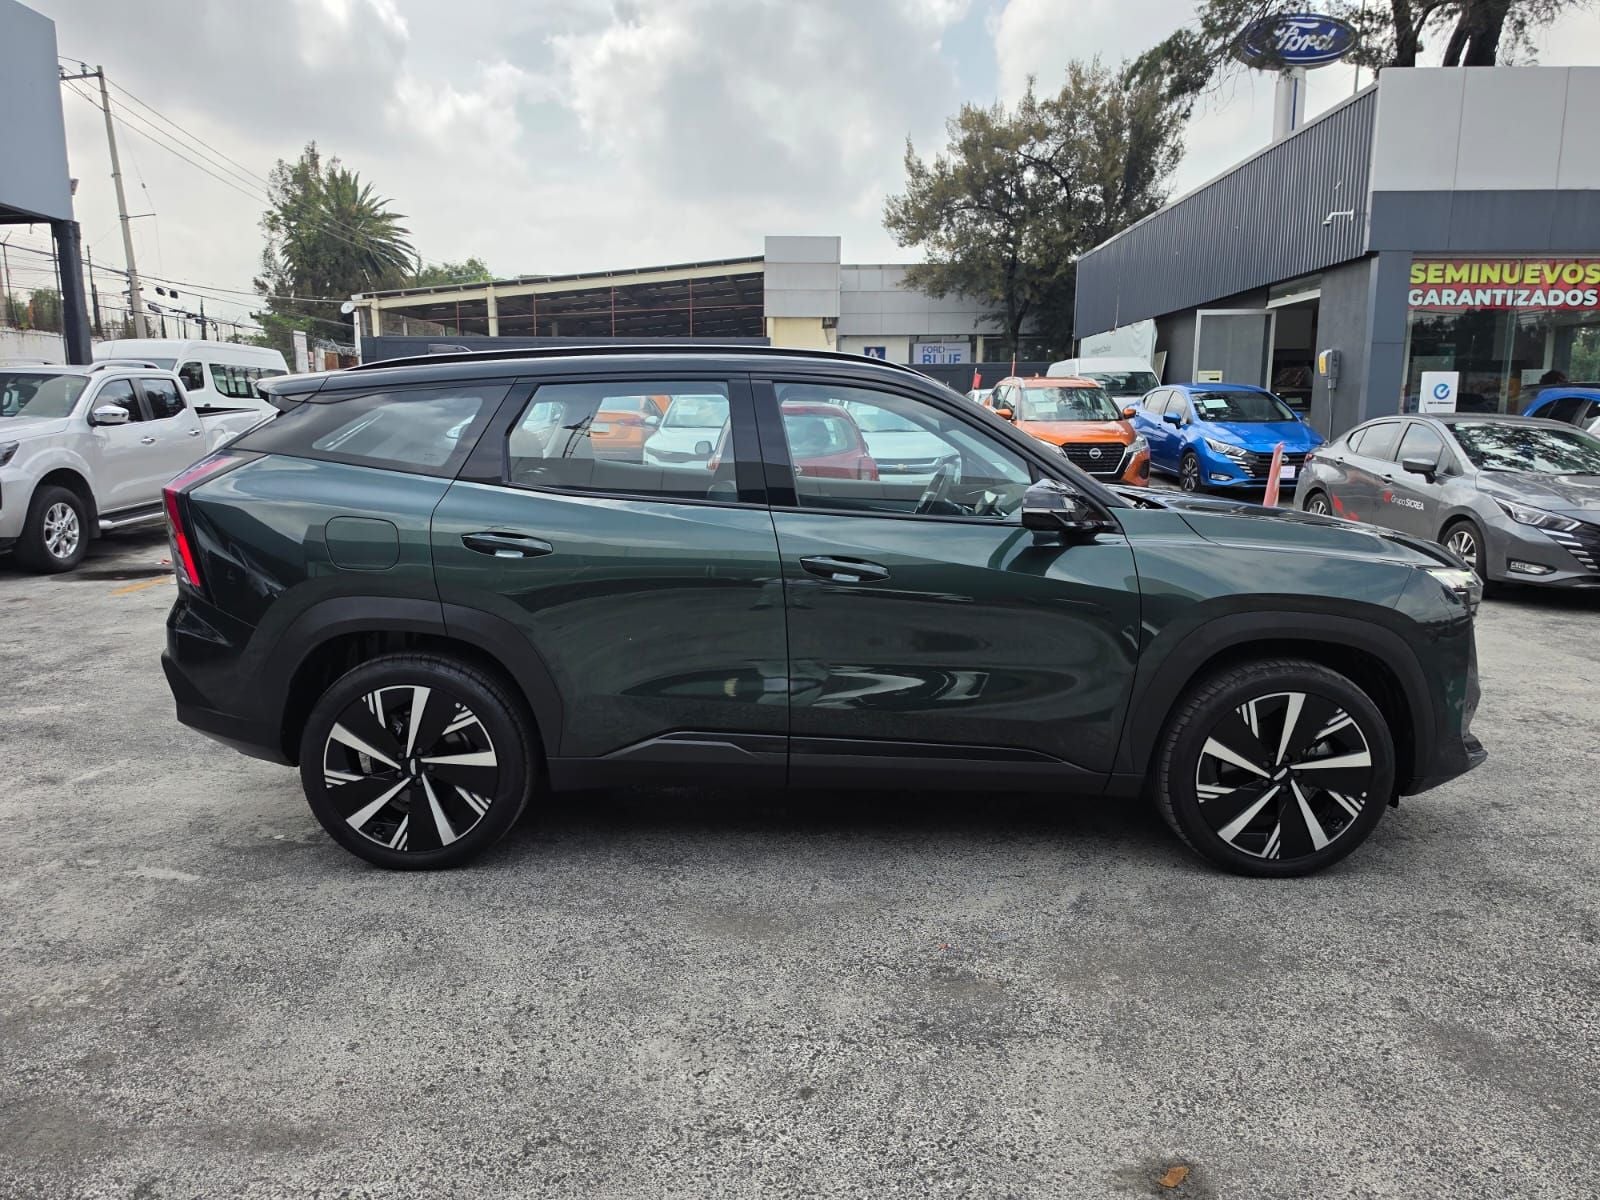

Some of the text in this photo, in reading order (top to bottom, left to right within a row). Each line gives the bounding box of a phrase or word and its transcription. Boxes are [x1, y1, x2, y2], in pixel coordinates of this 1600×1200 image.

[1273, 20, 1337, 52] Ford
[1409, 263, 1600, 285] SEMINUEVOS
[1408, 288, 1599, 307] GARANTIZADOS
[922, 345, 945, 354] FORD
[1405, 498, 1425, 511] SICREA
